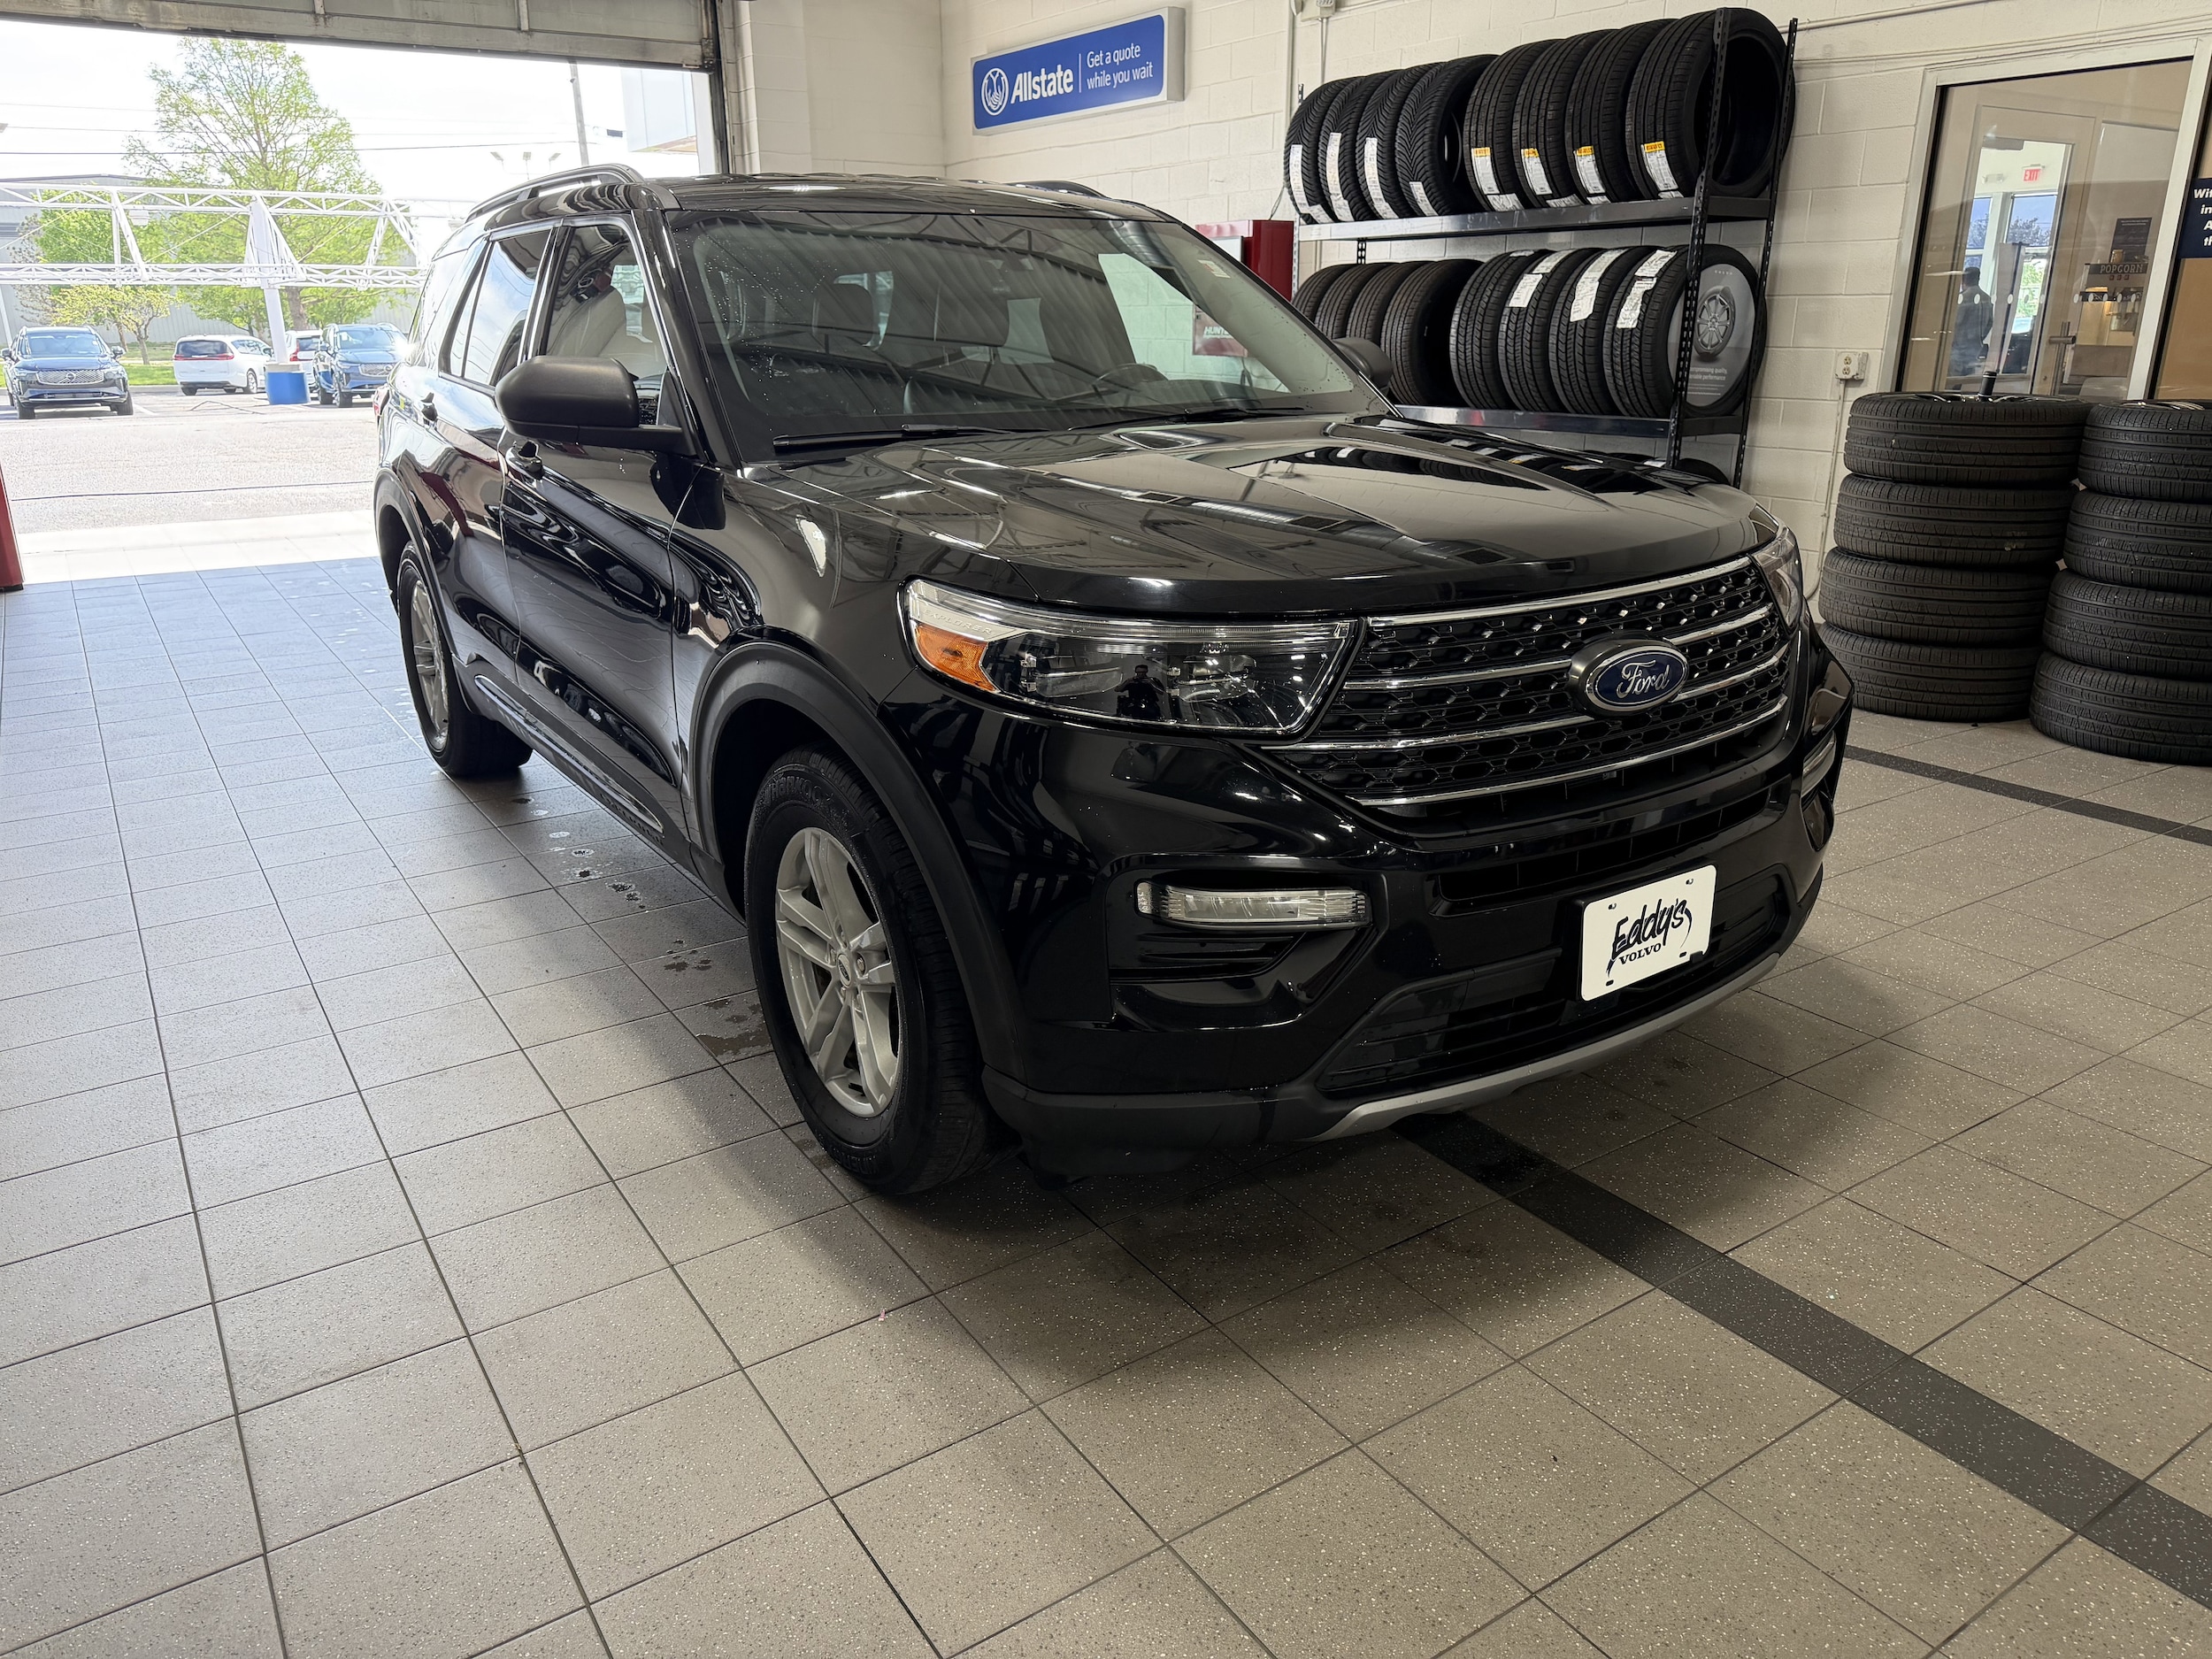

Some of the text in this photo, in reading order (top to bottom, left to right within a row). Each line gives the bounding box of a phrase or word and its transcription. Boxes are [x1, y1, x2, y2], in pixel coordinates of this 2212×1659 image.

[1087, 42, 1141, 68] Get a quote
[1010, 65, 1073, 104] Allstate
[1087, 62, 1153, 89] while you wait
[2024, 169, 2039, 181] EXIT
[2100, 264, 2143, 273] POPCORN
[923, 609, 992, 634] EXPLORER
[1617, 659, 1671, 699] Ford
[1611, 897, 1687, 961] Eddy's
[1619, 942, 1662, 964] VOLVO
